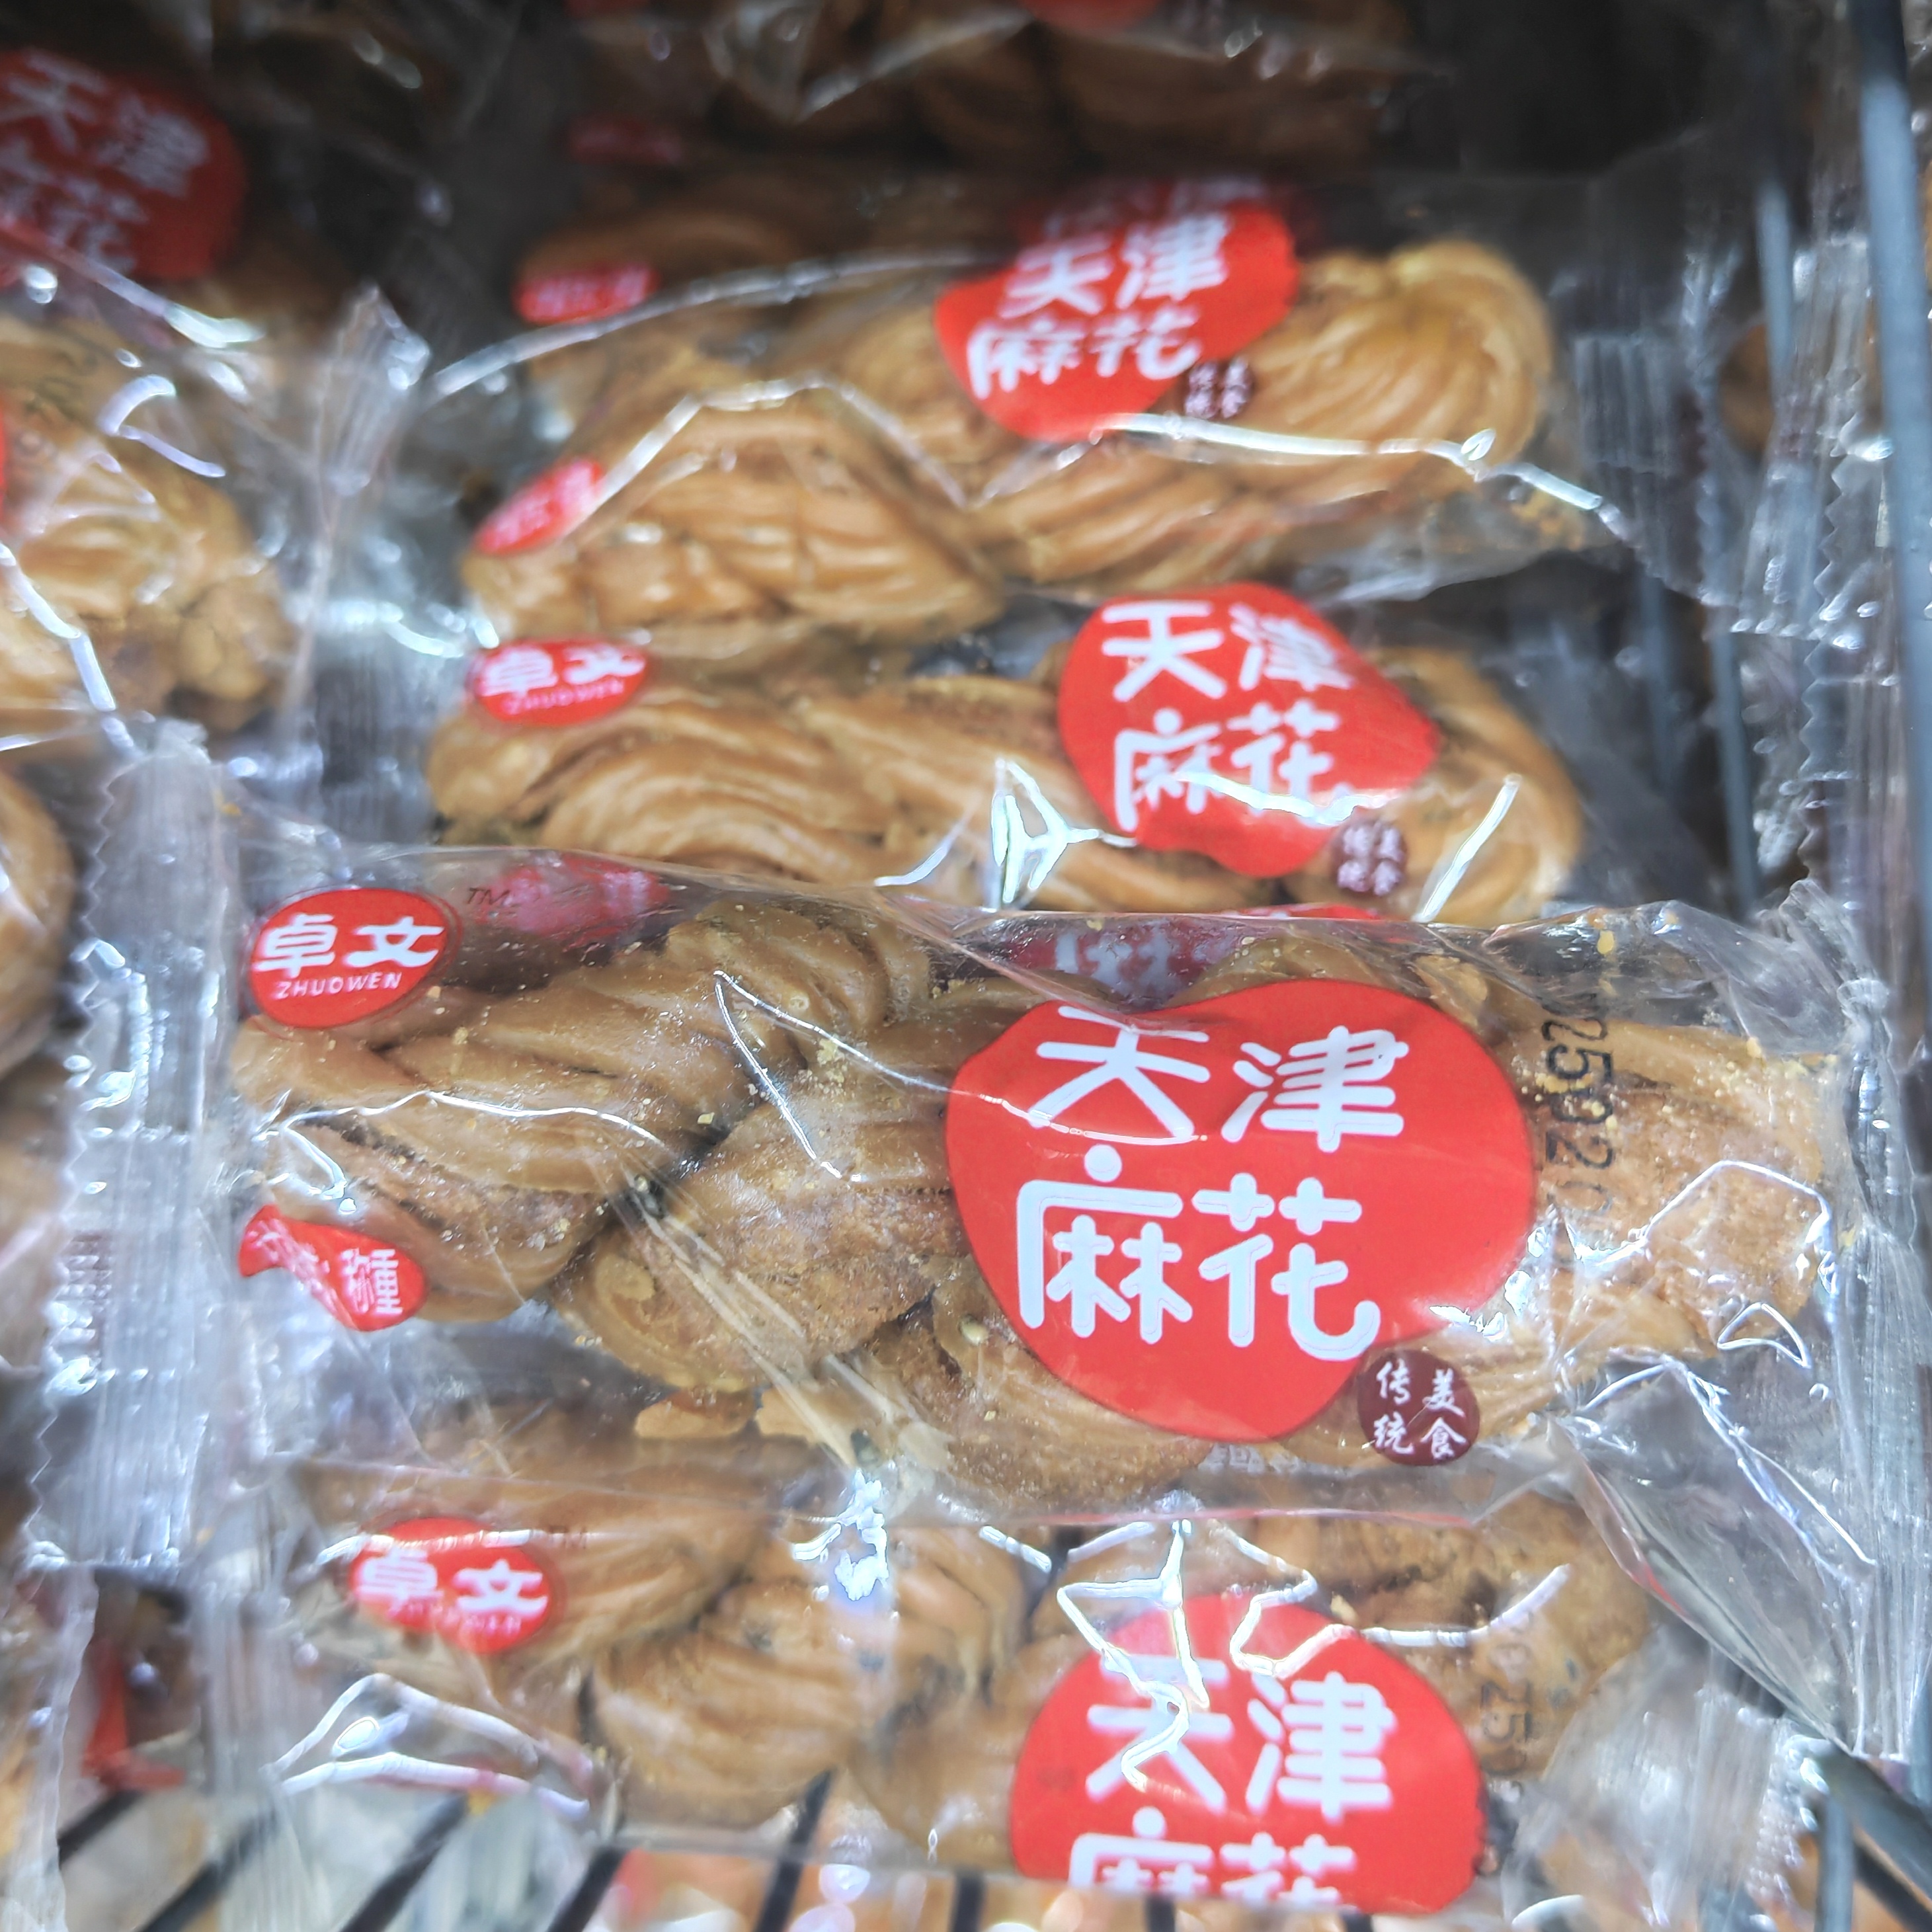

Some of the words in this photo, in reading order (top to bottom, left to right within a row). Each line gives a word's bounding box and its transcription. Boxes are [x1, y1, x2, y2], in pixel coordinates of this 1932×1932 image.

[997, 210, 1231, 321] 天津
[965, 305, 1203, 401] 麻花
[479, 645, 646, 698] 卓文
[1102, 599, 1357, 702] 天津
[1114, 701, 1355, 833] 麻花
[251, 911, 445, 979] 卓文
[271, 971, 402, 1000] ZHUOWEN
[1027, 1005, 1411, 1153] 天津
[1017, 1144, 1382, 1361] 麻花
[352, 1544, 549, 1620] 卓文
[1086, 1653, 1398, 1826] 天津
